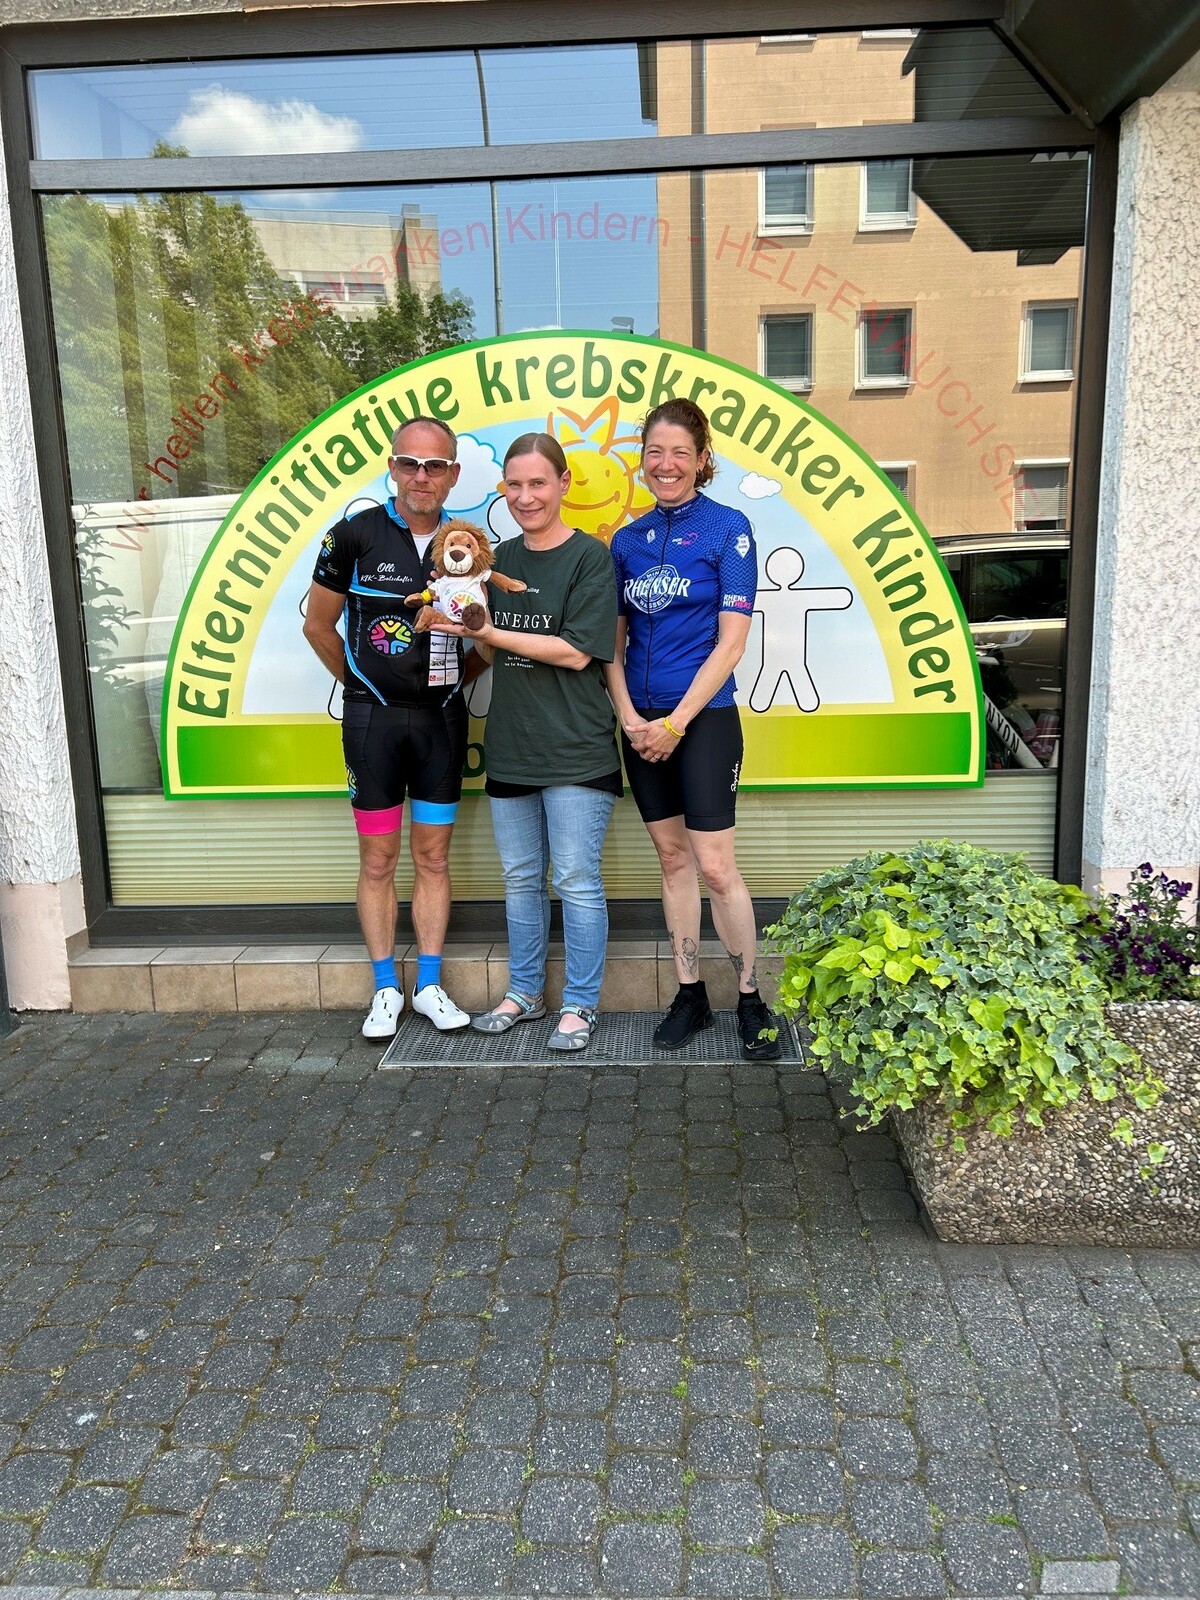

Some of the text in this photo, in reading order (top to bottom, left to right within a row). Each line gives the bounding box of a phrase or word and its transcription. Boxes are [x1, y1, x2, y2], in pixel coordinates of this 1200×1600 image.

[144, 372, 240, 485] helfen
[229, 221, 491, 374] krebskranken
[506, 202, 669, 246] Kindern
[716, 224, 893, 345] HELFEN
[886, 330, 998, 447] AUCH
[177, 342, 957, 718] Elterninitiative krebskranker Kinder
[377, 562, 396, 573] Olli
[624, 577, 691, 605] RHENSER
[723, 594, 747, 603] RHENS
[494, 612, 553, 628] ENERGY
